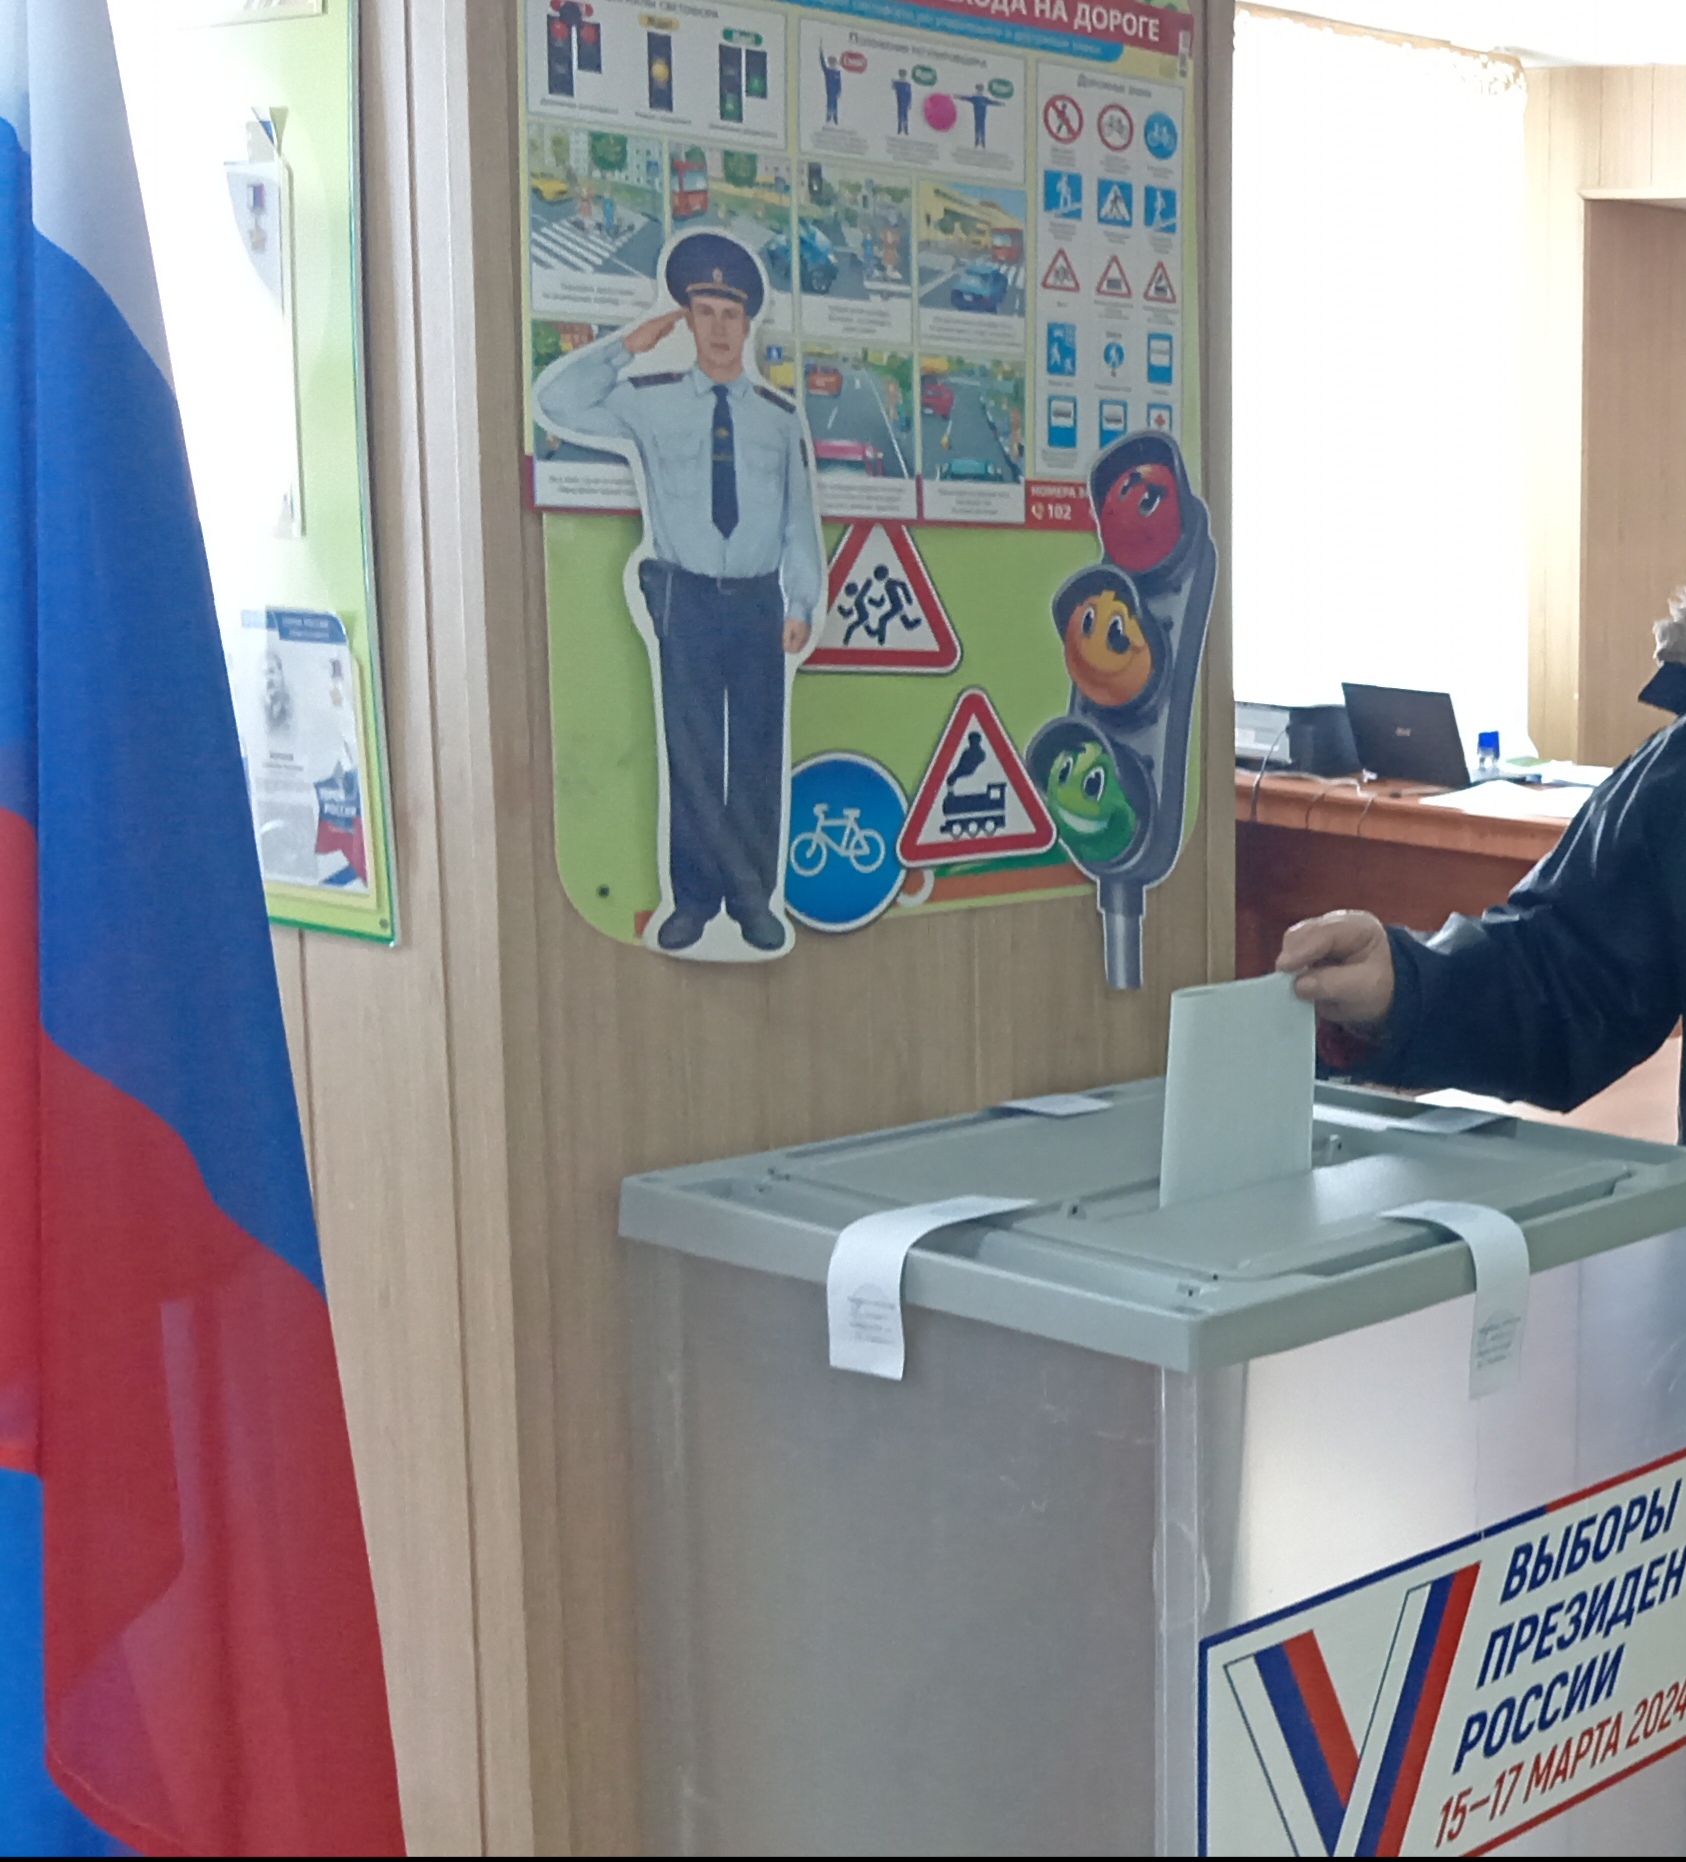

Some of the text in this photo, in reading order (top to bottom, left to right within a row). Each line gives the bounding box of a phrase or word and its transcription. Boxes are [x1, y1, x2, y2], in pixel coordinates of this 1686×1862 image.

[1033, 0, 1068, 23] НА
[1073, 5, 1161, 42] ДОРОГЕ
[1047, 503, 1072, 521] 102
[1500, 1478, 1683, 1605] ВЫБОРЫ
[1452, 1642, 1626, 1775] РОССИИ
[1524, 1712, 1621, 1804] МАРТА
